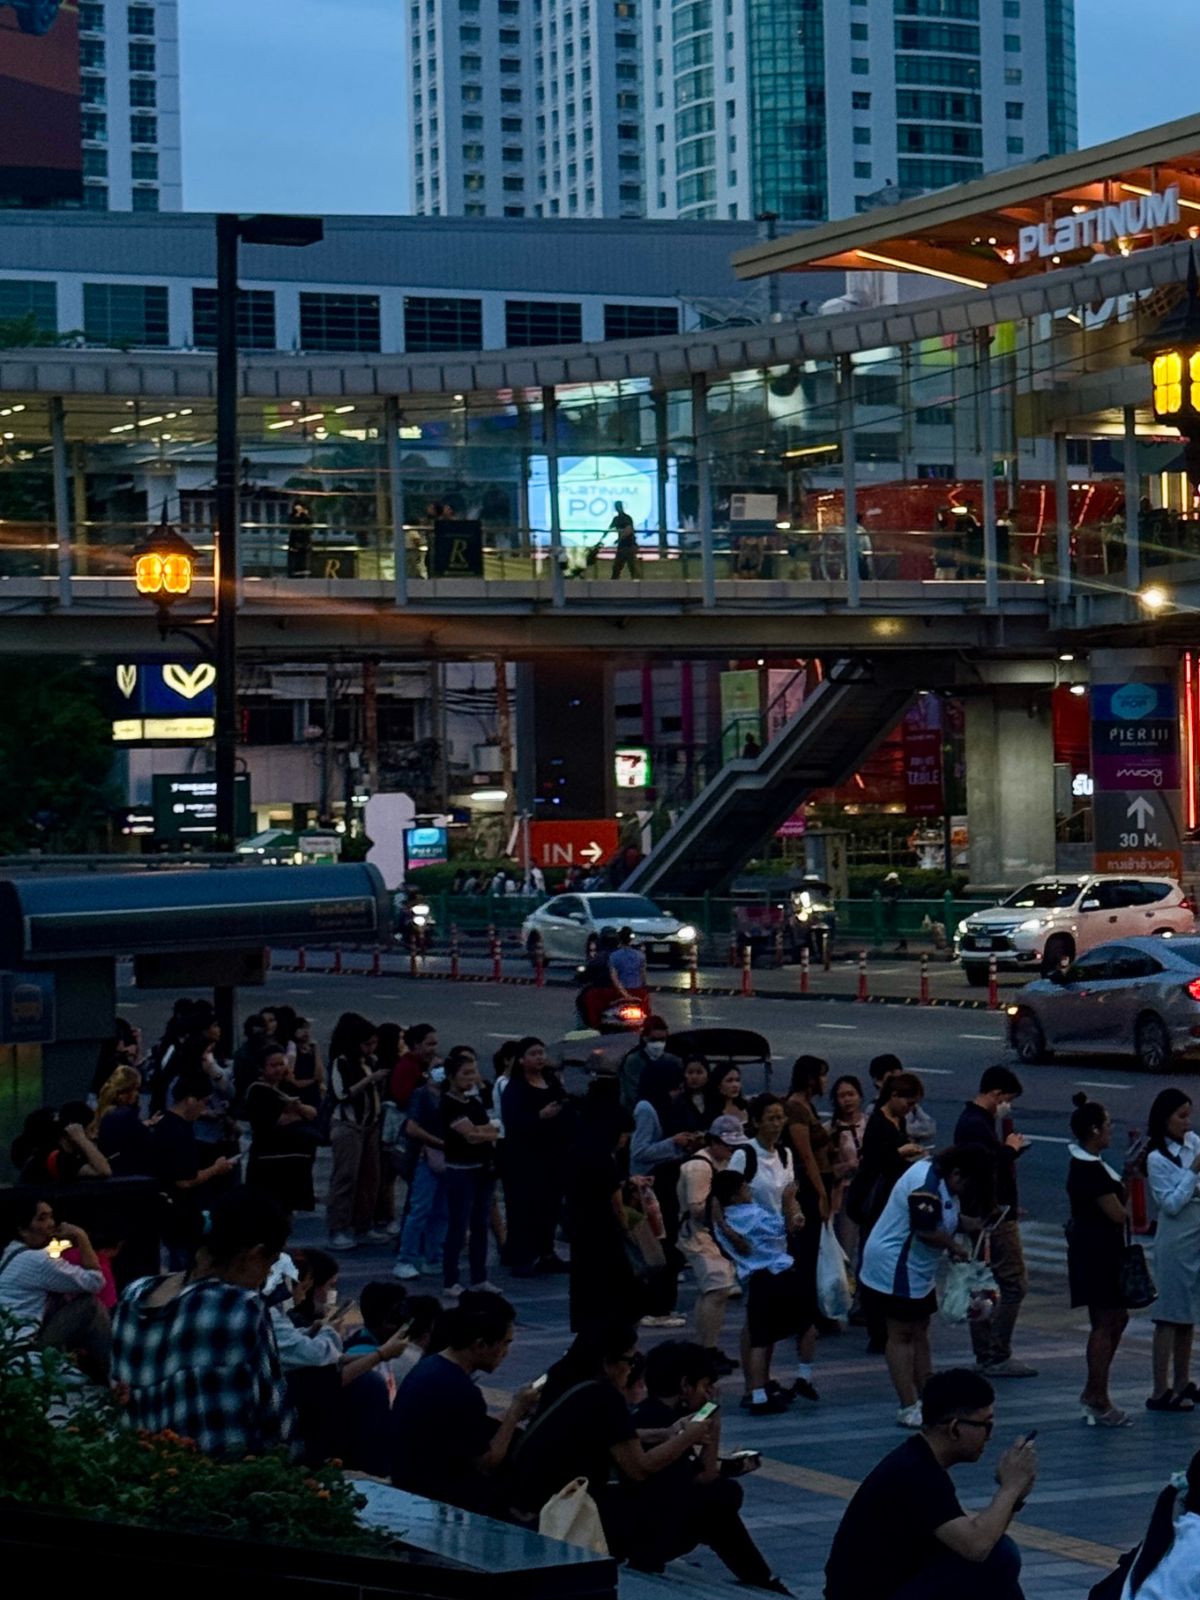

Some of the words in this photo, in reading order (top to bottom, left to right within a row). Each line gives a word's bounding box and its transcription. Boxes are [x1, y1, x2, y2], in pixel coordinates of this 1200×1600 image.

[1109, 727, 1147, 741] PIER
[1119, 832, 1139, 848] 30
[1143, 832, 1163, 848] M.
[542, 842, 573, 865] IN
